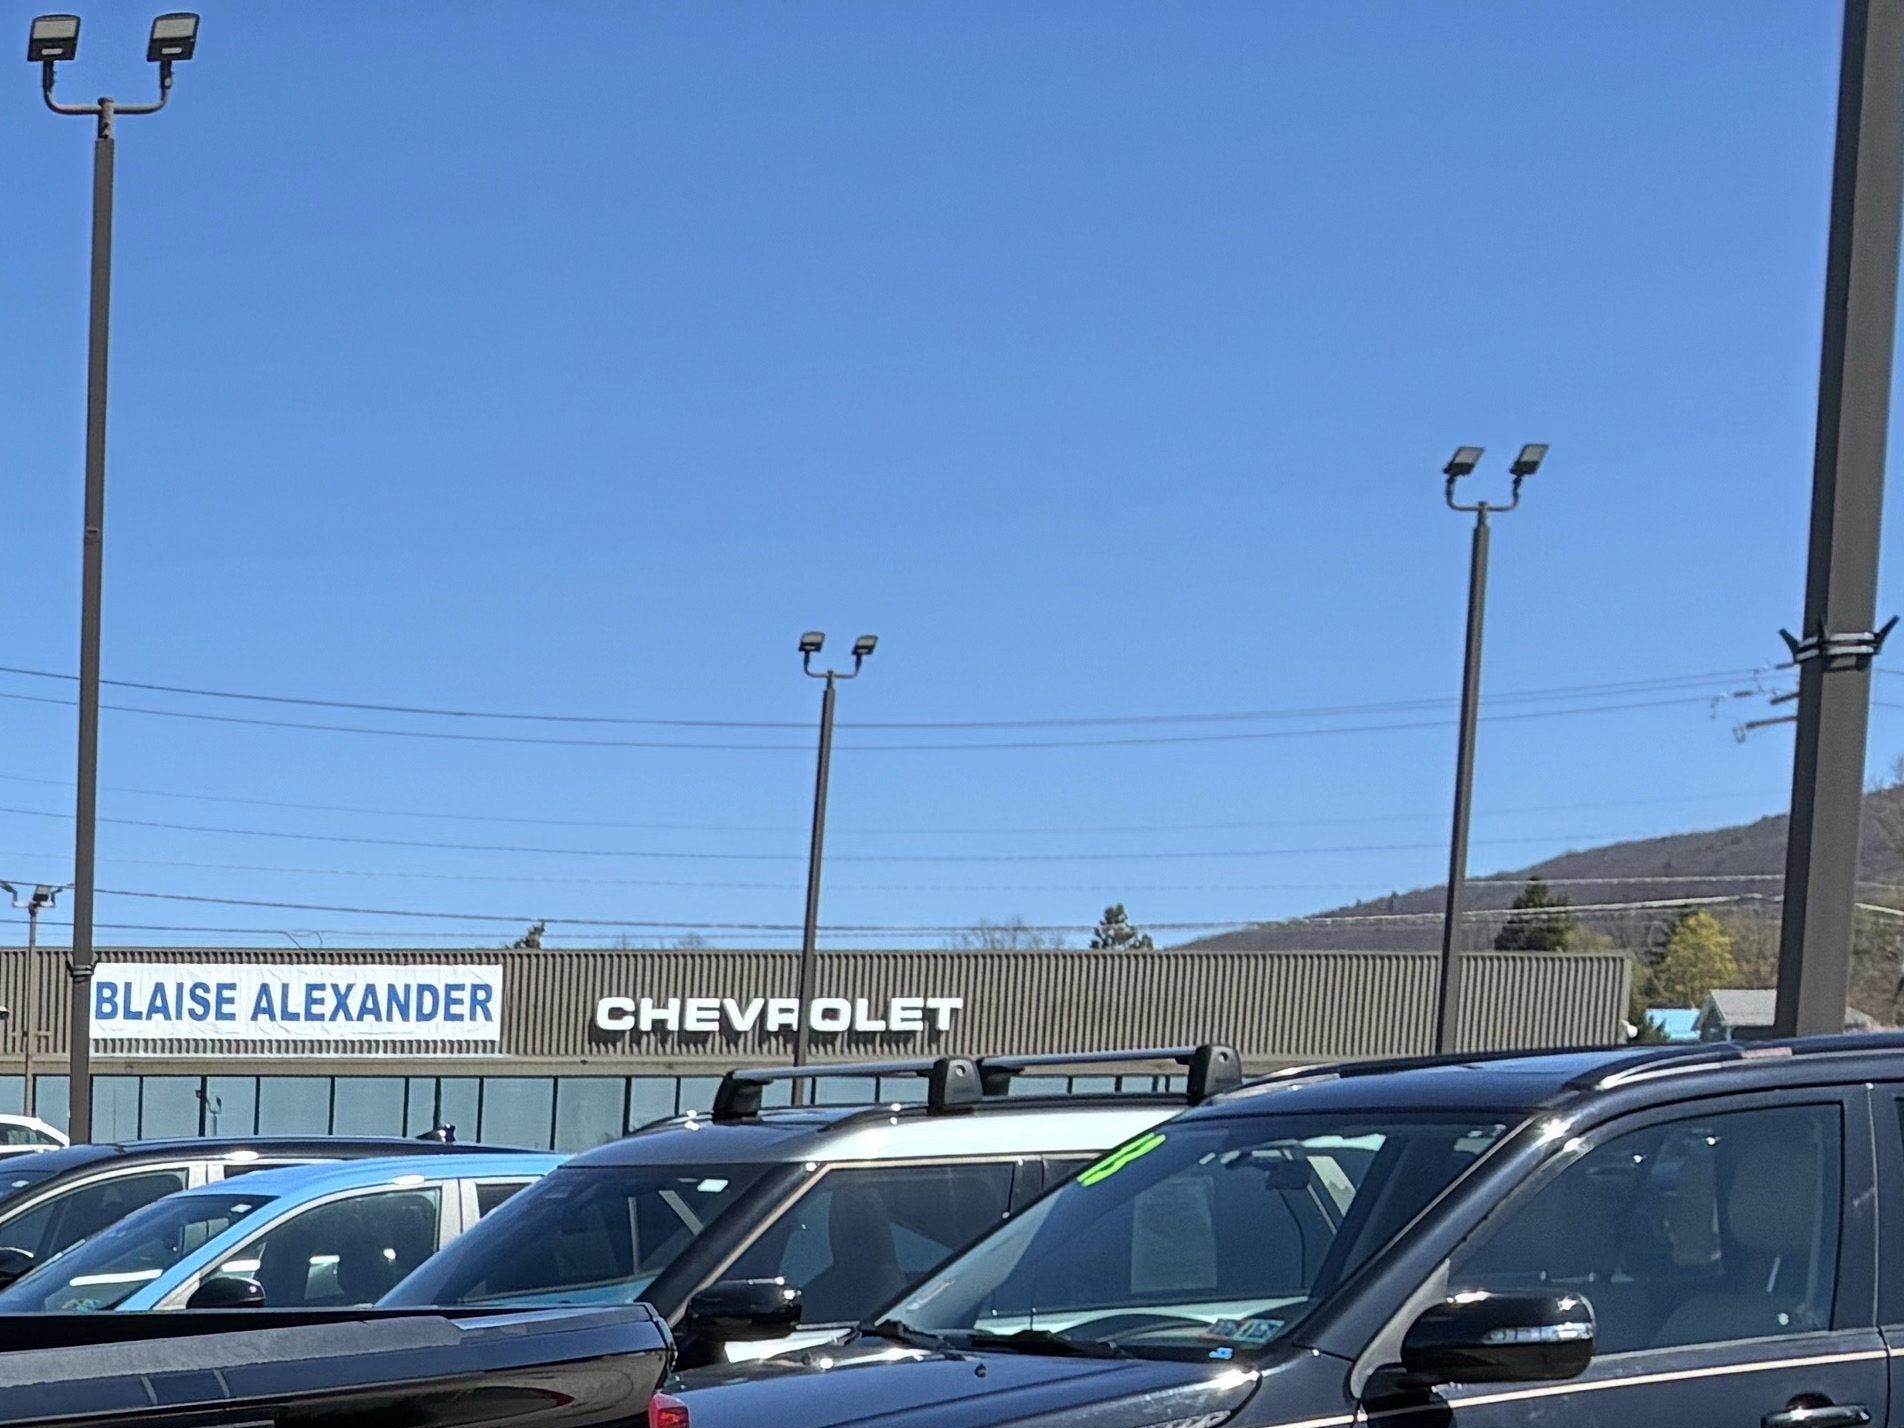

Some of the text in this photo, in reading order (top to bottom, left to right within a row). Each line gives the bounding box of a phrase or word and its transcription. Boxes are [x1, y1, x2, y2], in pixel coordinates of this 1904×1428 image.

[94, 981, 494, 1023] BLAISE ALEXANDER
[596, 996, 964, 1033] CHEVROLET
